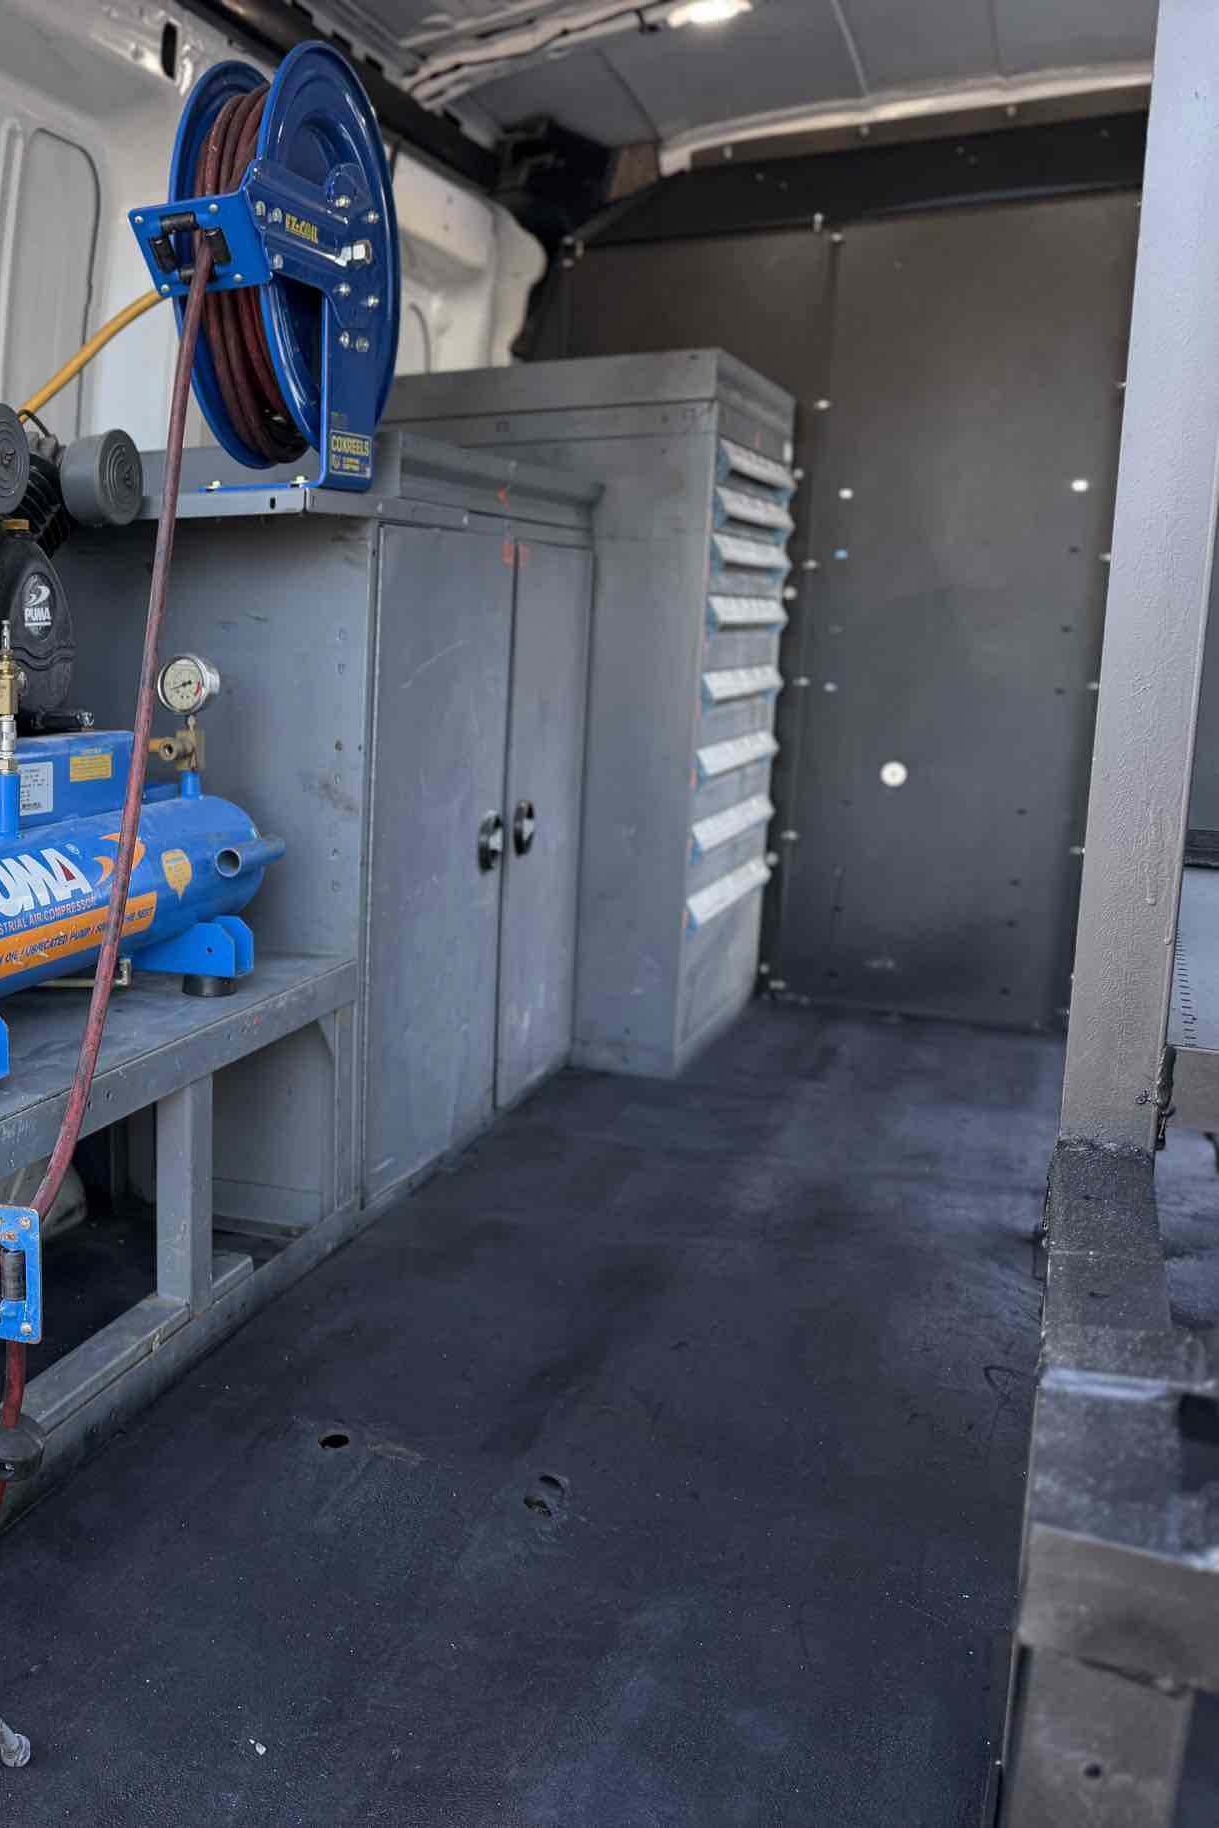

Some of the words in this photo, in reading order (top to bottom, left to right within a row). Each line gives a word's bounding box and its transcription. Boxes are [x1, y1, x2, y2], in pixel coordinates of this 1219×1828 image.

[332, 435, 370, 457] COXREELS
[24, 607, 52, 621] PUMA
[29, 912, 42, 926] AIR
